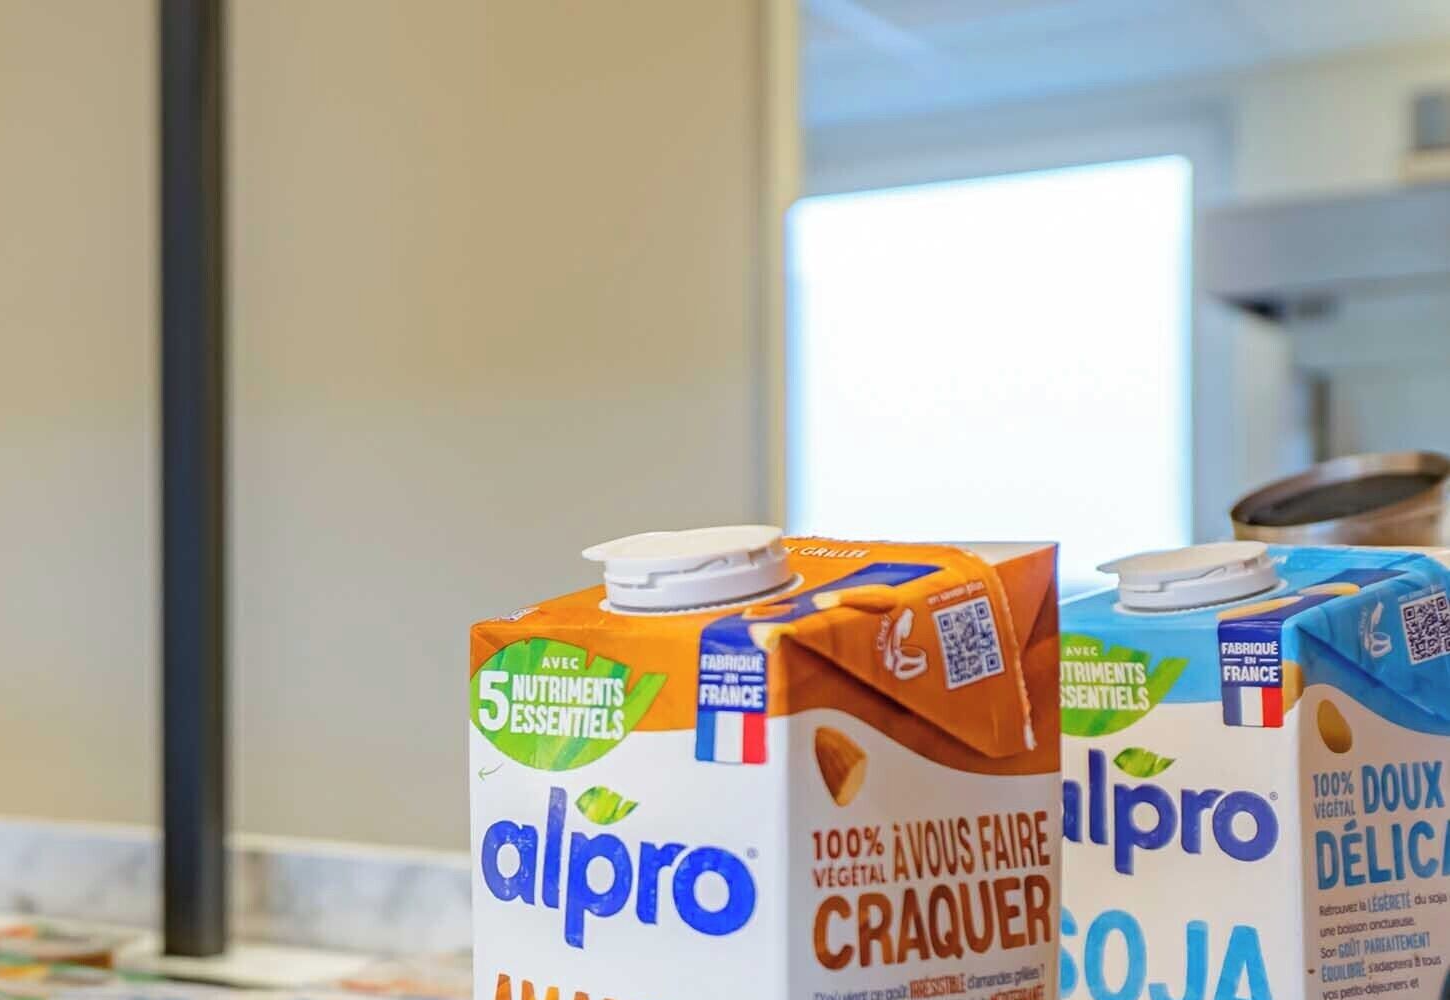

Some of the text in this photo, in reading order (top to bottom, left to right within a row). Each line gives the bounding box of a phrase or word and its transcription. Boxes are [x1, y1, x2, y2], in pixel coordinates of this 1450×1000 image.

[1066, 646, 1099, 657] AVEC
[1221, 640, 1279, 655] FABRIQUÉ
[1243, 655, 1256, 665] EN
[542, 656, 579, 670] AVEC
[700, 653, 765, 672] FABRIQUÉ
[1222, 664, 1279, 683] FRANCE
[478, 670, 625, 732] 5 NUTRIMENTS
[700, 684, 764, 708] FRANCE
[510, 704, 625, 740] ESSENTIELS
[1313, 771, 1355, 798] 100%
[1362, 761, 1445, 814] DOUX
[1313, 797, 1356, 819] VÉGÉTAL
[813, 826, 885, 860] 100%
[907, 817, 975, 878] VOUS
[978, 811, 1051, 872] FAIRE
[481, 786, 758, 949] alpro
[813, 861, 887, 888] VÉGÉTAL
[813, 875, 1052, 970] CRAQUER
[1320, 922, 1368, 938] une boisson
[1320, 946, 1336, 960] Son
[1364, 931, 1430, 954] PARFAITEMENT
[1322, 989, 1338, 1000] vos
